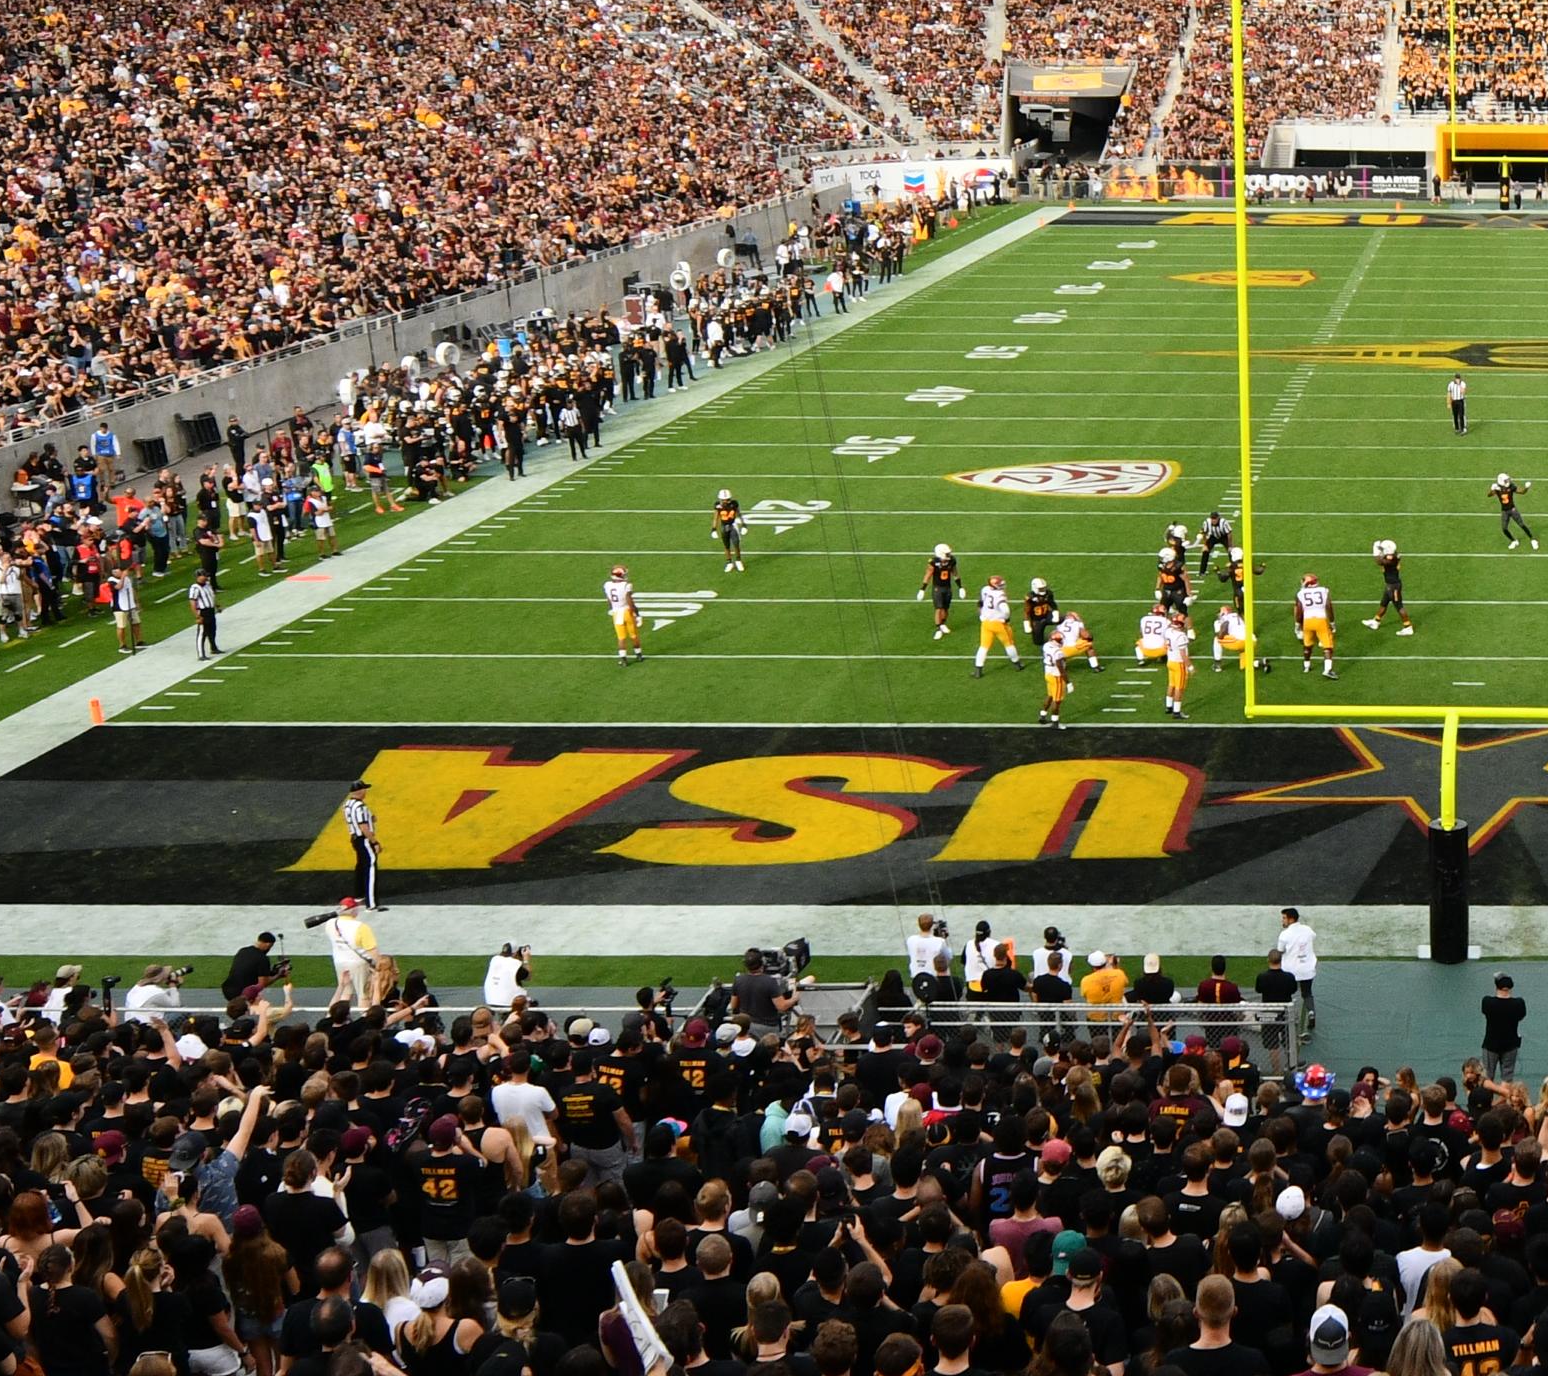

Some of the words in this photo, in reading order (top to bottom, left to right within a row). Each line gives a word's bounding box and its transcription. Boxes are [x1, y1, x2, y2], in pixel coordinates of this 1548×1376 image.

[860, 170, 881, 180] TOCA
[1156, 212, 1429, 225] ASU
[965, 345, 1029, 360] 50
[744, 500, 833, 534] 20
[611, 588, 619, 602] 6
[1304, 591, 1323, 607] 53
[1144, 620, 1163, 635] 62
[599, 1065, 625, 1076] TILLMAN
[421, 1167, 456, 1176] TILLMAN
[421, 1177, 457, 1200] 42
[1451, 1338, 1500, 1358] TILLMAN
